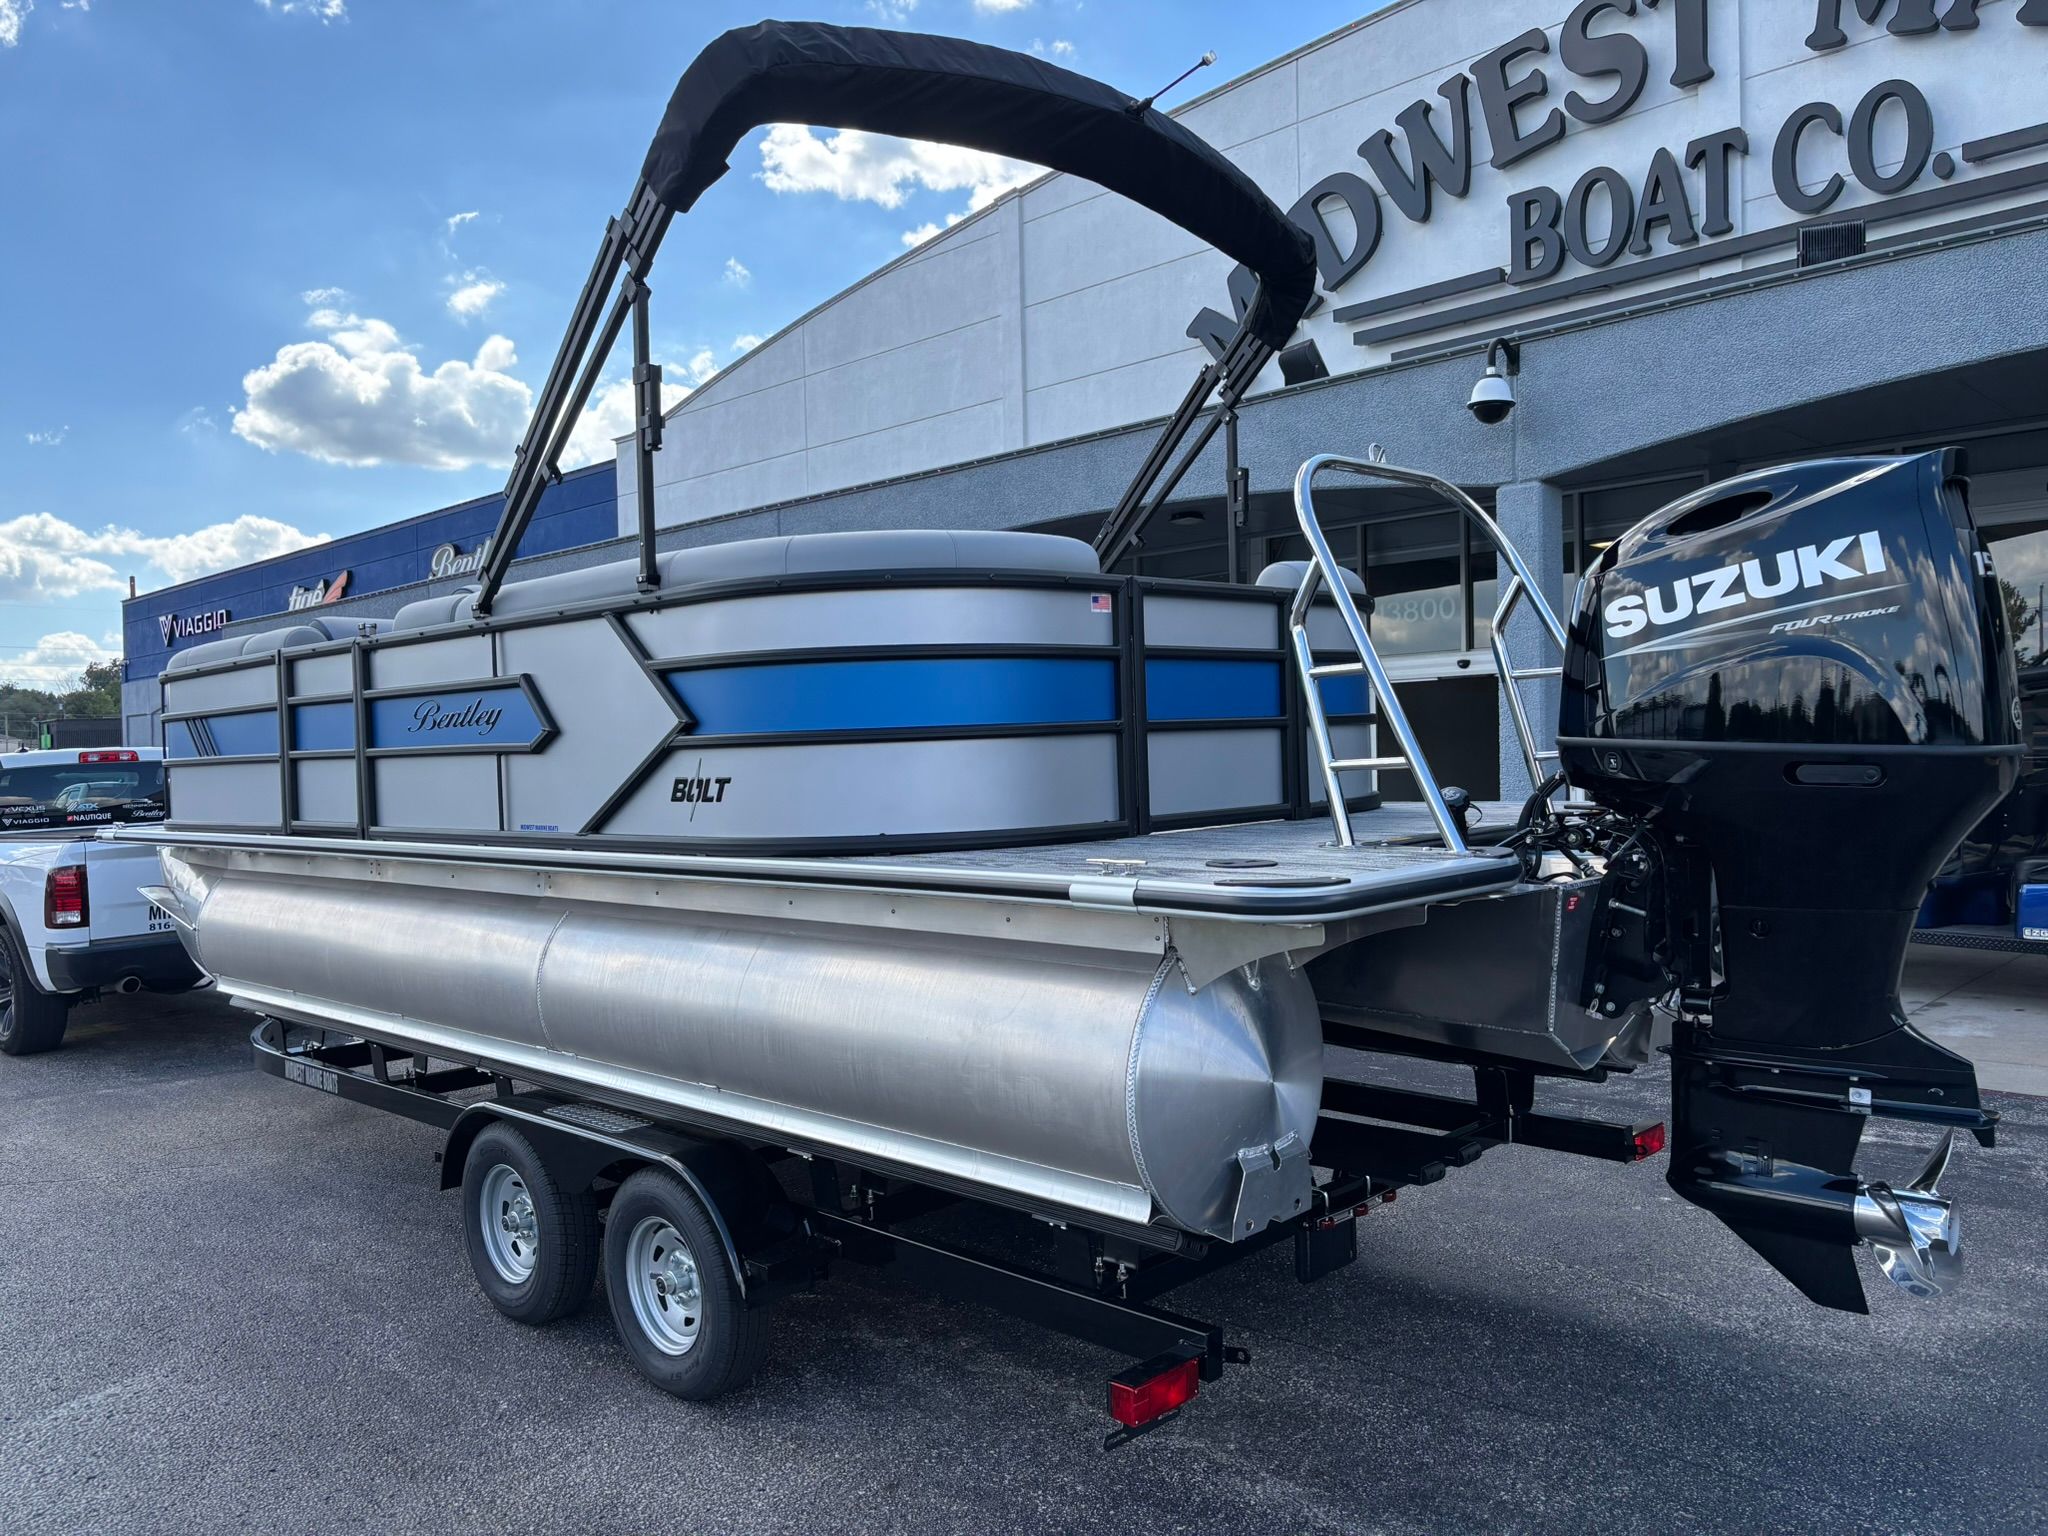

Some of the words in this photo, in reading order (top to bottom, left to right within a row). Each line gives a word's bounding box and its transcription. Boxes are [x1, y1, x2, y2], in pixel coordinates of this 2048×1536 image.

[1186, 0, 1716, 363] MDWEST
[1505, 127, 1748, 285] BOAT
[1772, 79, 1955, 214] CO.
[428, 538, 492, 580] Bentl
[1973, 551, 1997, 576] 15
[1604, 530, 1887, 639] SUZUKI
[173, 608, 227, 638] VIAGGIO
[1768, 614, 1833, 635] FOUR
[1831, 605, 1901, 622] STROKE
[407, 697, 502, 736] Bentley
[670, 776, 732, 803] BOLT
[13, 817, 50, 825] VIAGGIO
[73, 812, 112, 821] NAUTIQUE
